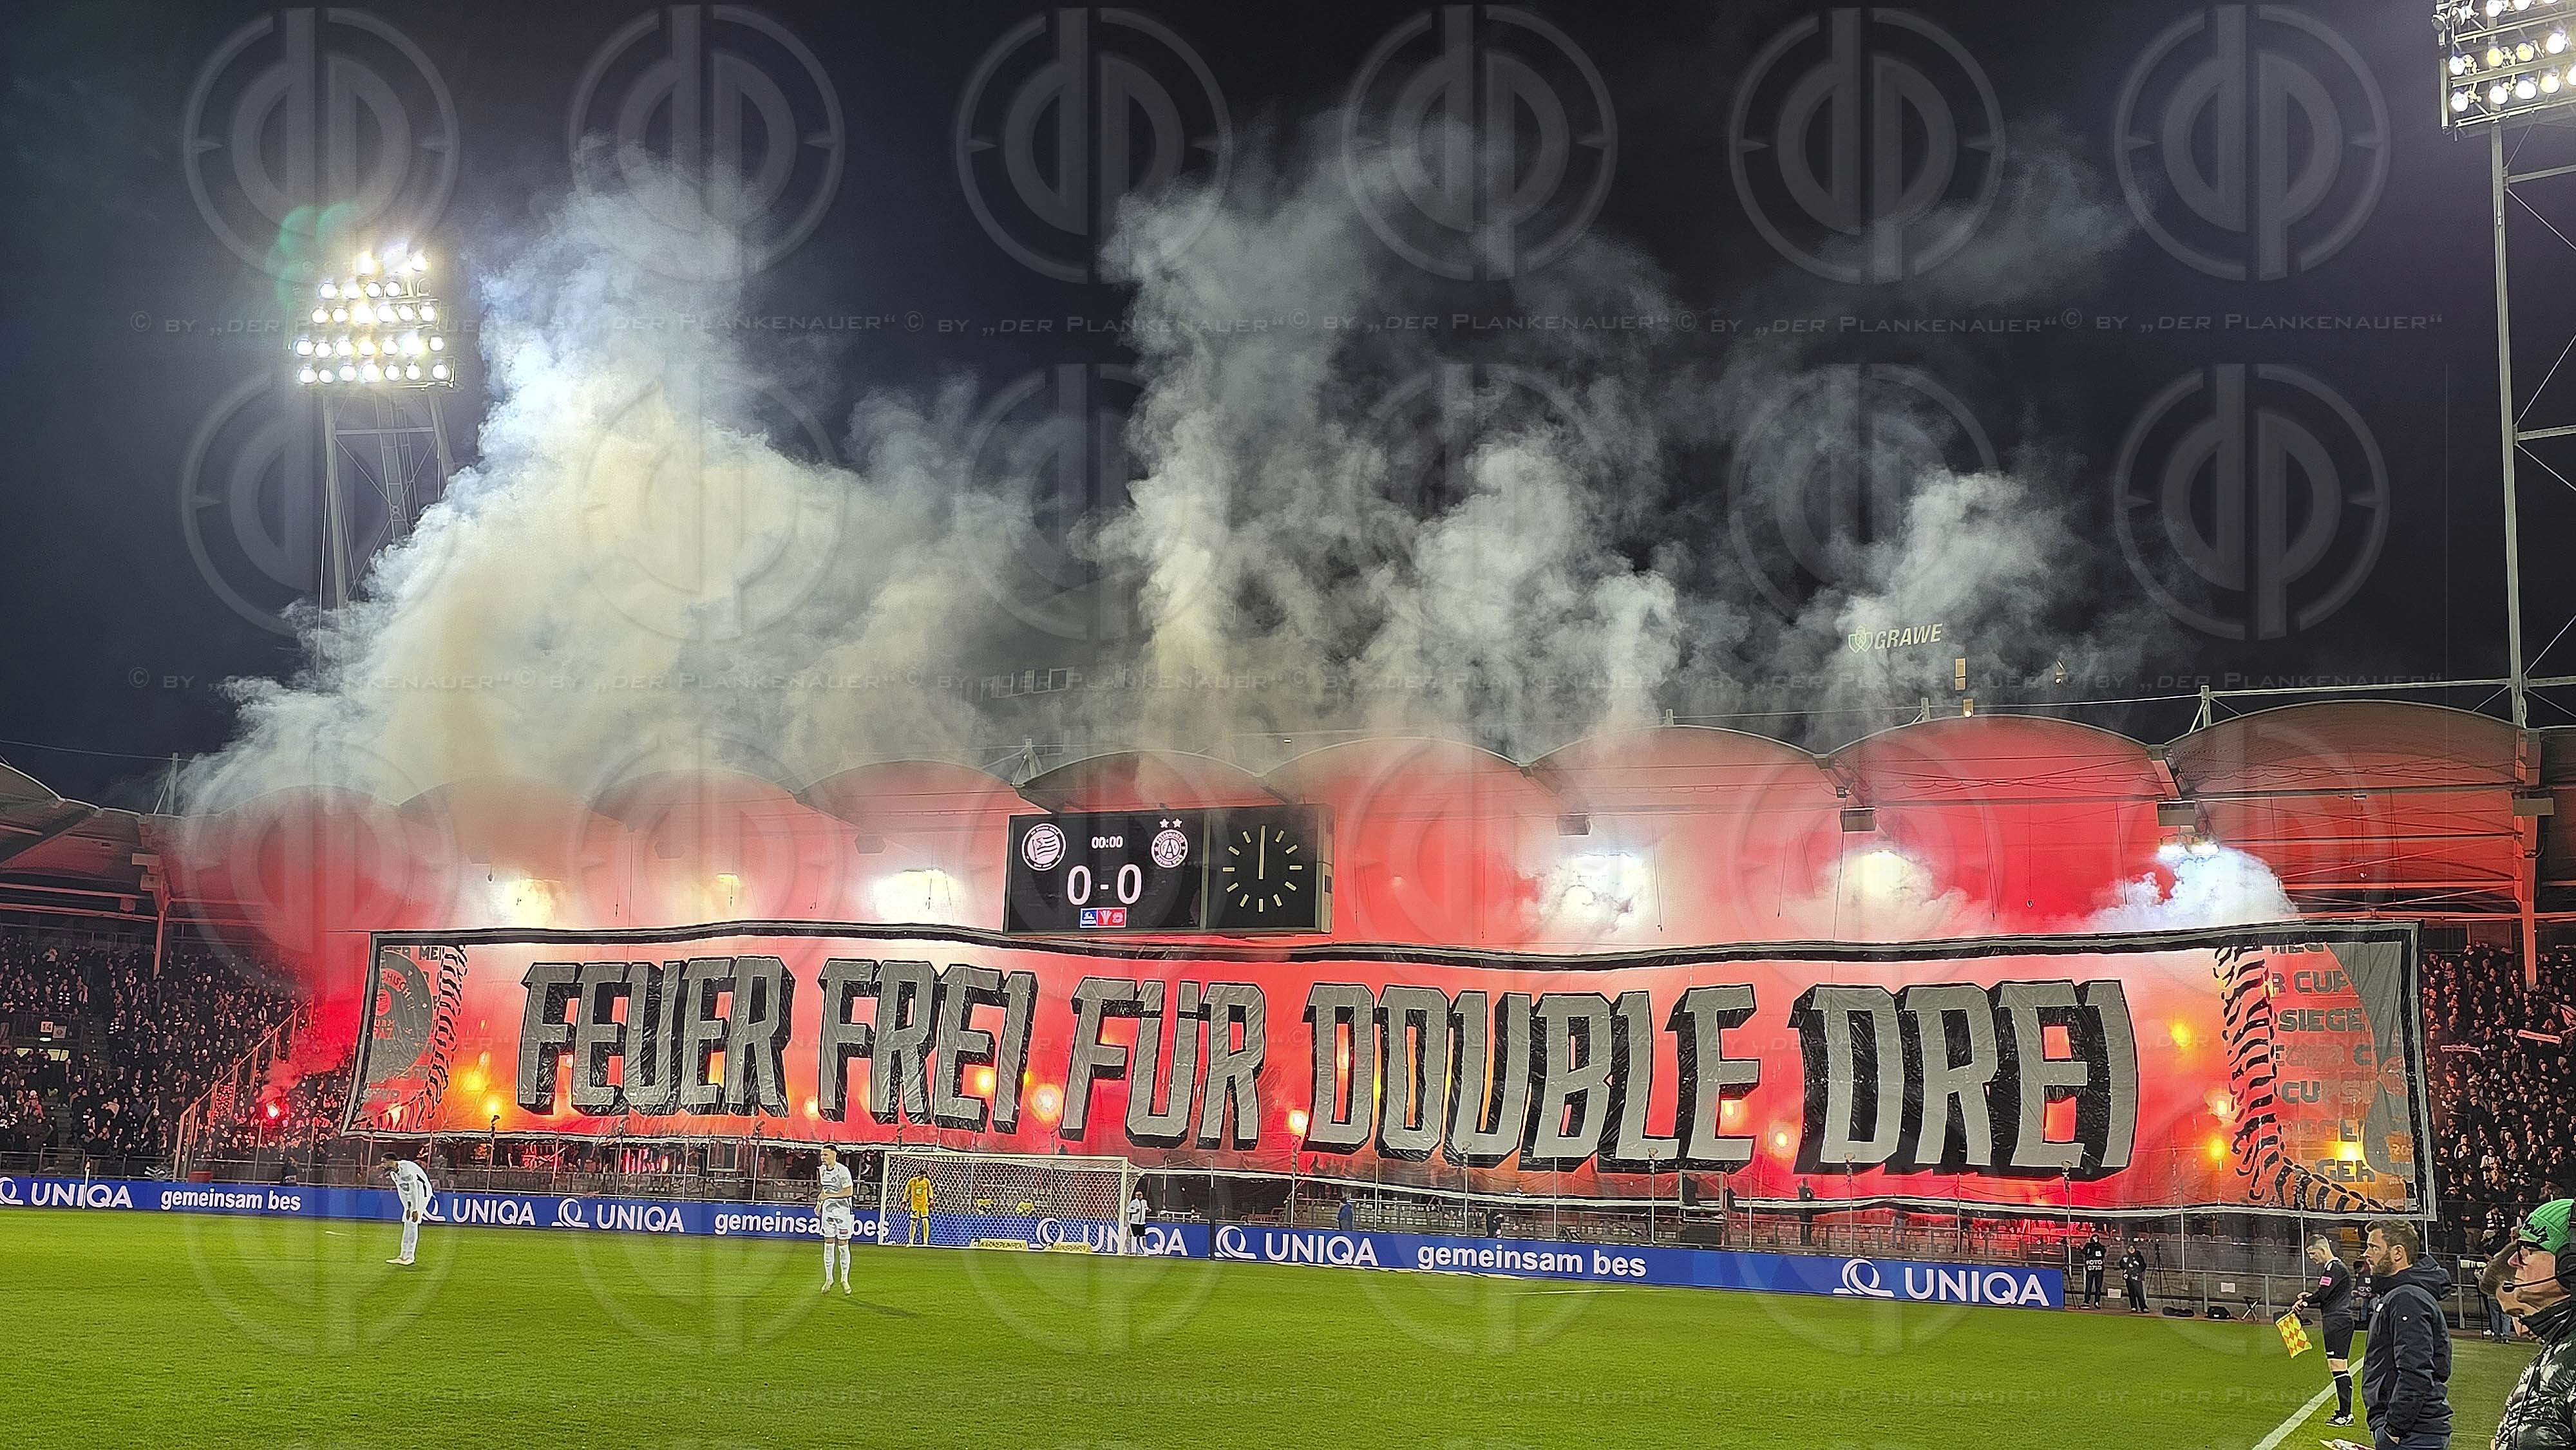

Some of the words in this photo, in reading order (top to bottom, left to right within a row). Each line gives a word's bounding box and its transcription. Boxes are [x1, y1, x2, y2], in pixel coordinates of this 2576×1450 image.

[1874, 623, 1943, 650] GRAWE
[1092, 836, 1123, 849] 00:00
[518, 956, 797, 1118] FEUER
[817, 956, 1039, 1134] FREI
[1058, 976, 1267, 1151] FÜR
[1302, 983, 1762, 1173] DOUBLE
[1787, 979, 2139, 1181] DREI
[31, 1182, 133, 1209] UNIQA
[160, 1187, 263, 1210] gemeinsam
[267, 1187, 302, 1211] bes
[452, 1198, 536, 1227] UNIQA
[596, 1204, 685, 1232] UNIQA
[714, 1210, 824, 1236] gemeinsa
[1265, 1232, 1379, 1266] UNIQA
[1417, 1244, 1582, 1274] gemeinsam
[1593, 1249, 1647, 1277] bes
[1904, 1266, 2050, 1307] UNIQA
